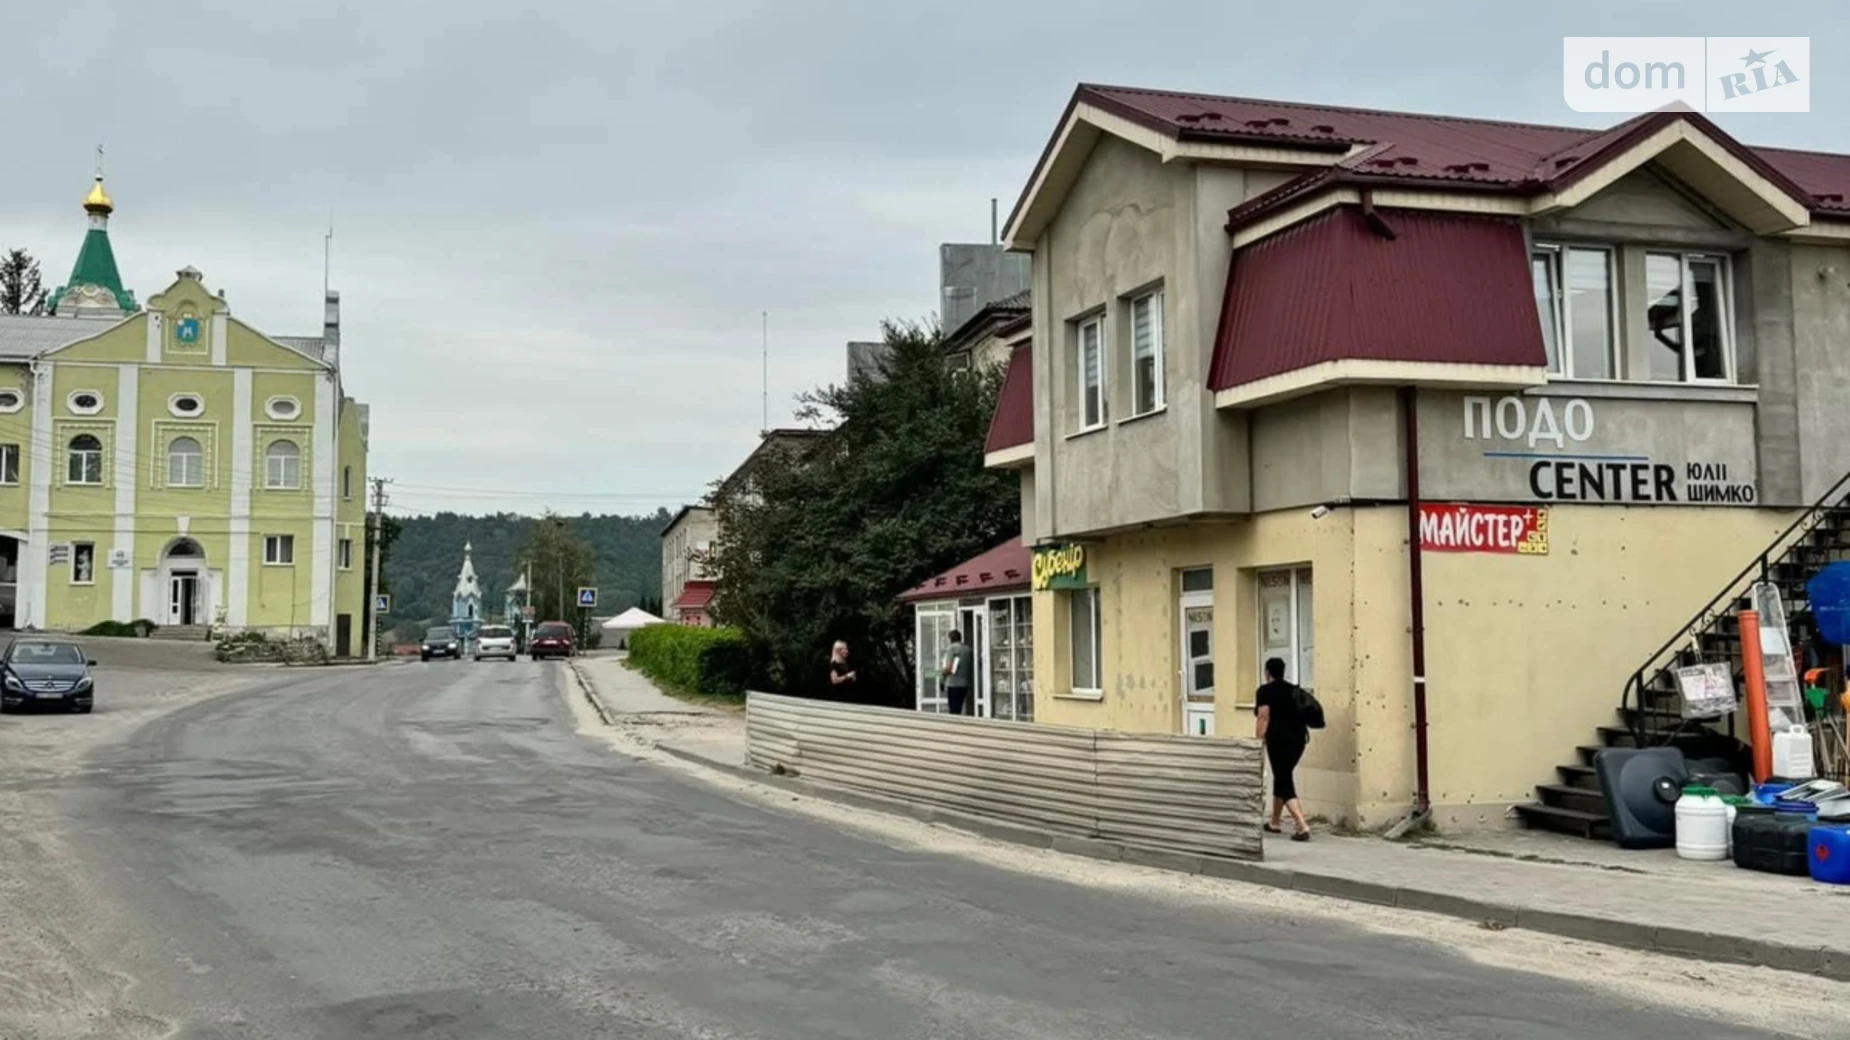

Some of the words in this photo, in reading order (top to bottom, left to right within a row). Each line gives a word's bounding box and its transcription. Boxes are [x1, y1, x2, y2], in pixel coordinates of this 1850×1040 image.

[1463, 396, 1595, 449] ПОДО
[1529, 460, 1677, 502] CENTER
[1687, 484, 1754, 503] ШИМКО
